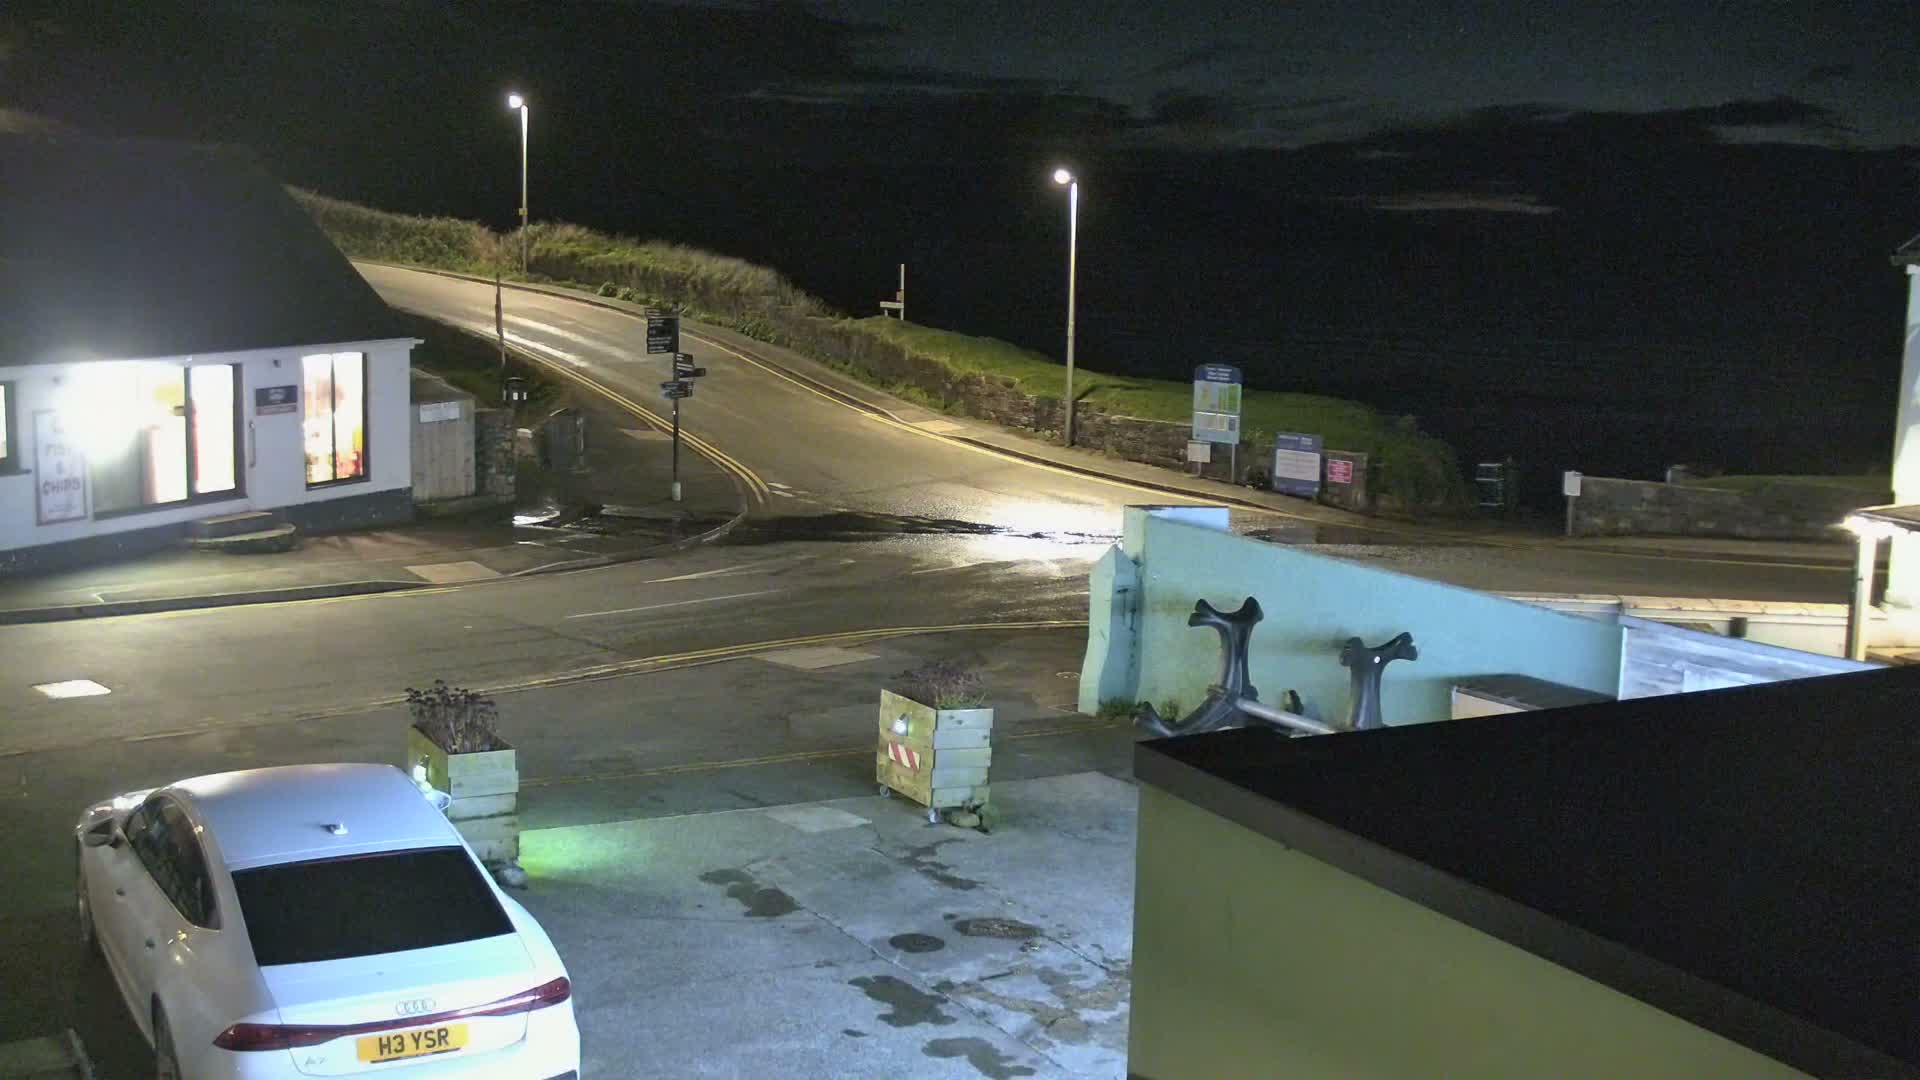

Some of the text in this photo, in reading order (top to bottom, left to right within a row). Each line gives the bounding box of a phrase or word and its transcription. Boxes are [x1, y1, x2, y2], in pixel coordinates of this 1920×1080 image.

[42, 476, 81, 497] CHIPS
[378, 1028, 450, 1056] H3 YSR
